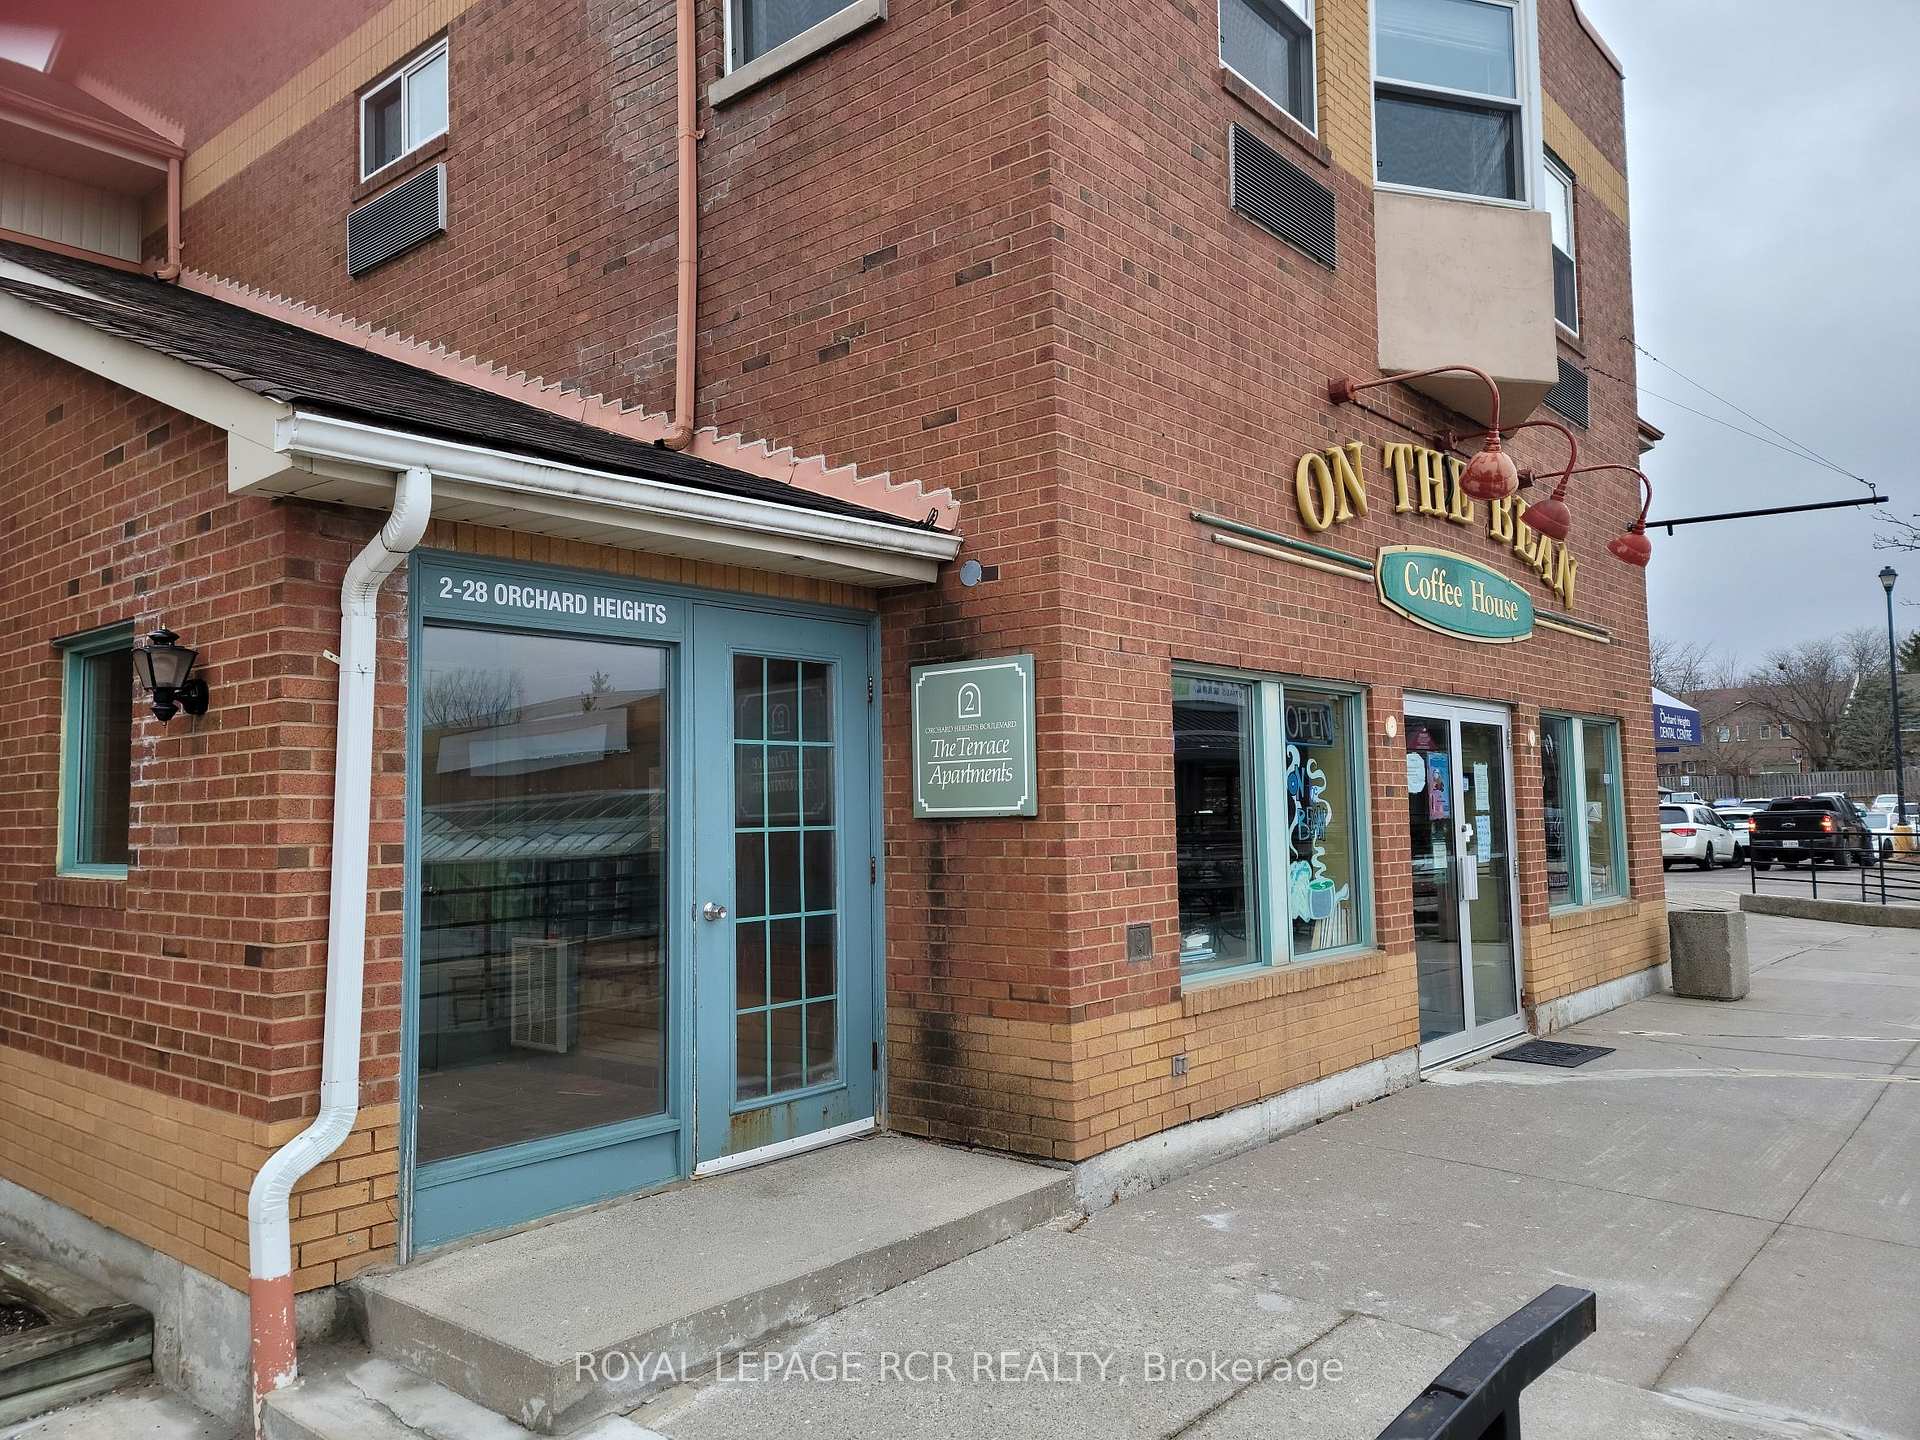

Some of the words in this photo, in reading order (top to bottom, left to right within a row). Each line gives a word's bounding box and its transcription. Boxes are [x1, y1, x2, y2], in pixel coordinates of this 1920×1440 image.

[1296, 442, 1368, 532] ON
[1384, 442, 1475, 525] THE
[439, 577, 488, 603] 2-28
[494, 583, 588, 615] ORCHARD
[593, 596, 667, 625] HEIGHTS
[1404, 561, 1463, 608] Coffee
[1472, 580, 1520, 622] House
[965, 691, 975, 711] 2
[925, 726, 954, 735] ORCHARD
[954, 723, 979, 733] HEIGHTS
[980, 720, 1017, 731] BOULEVARD
[1286, 705, 1332, 740] OPEN
[1660, 726, 1676, 739] DENTAL
[931, 739, 956, 758] The
[957, 737, 1010, 757] Terrace
[928, 762, 1013, 790] Apartments
